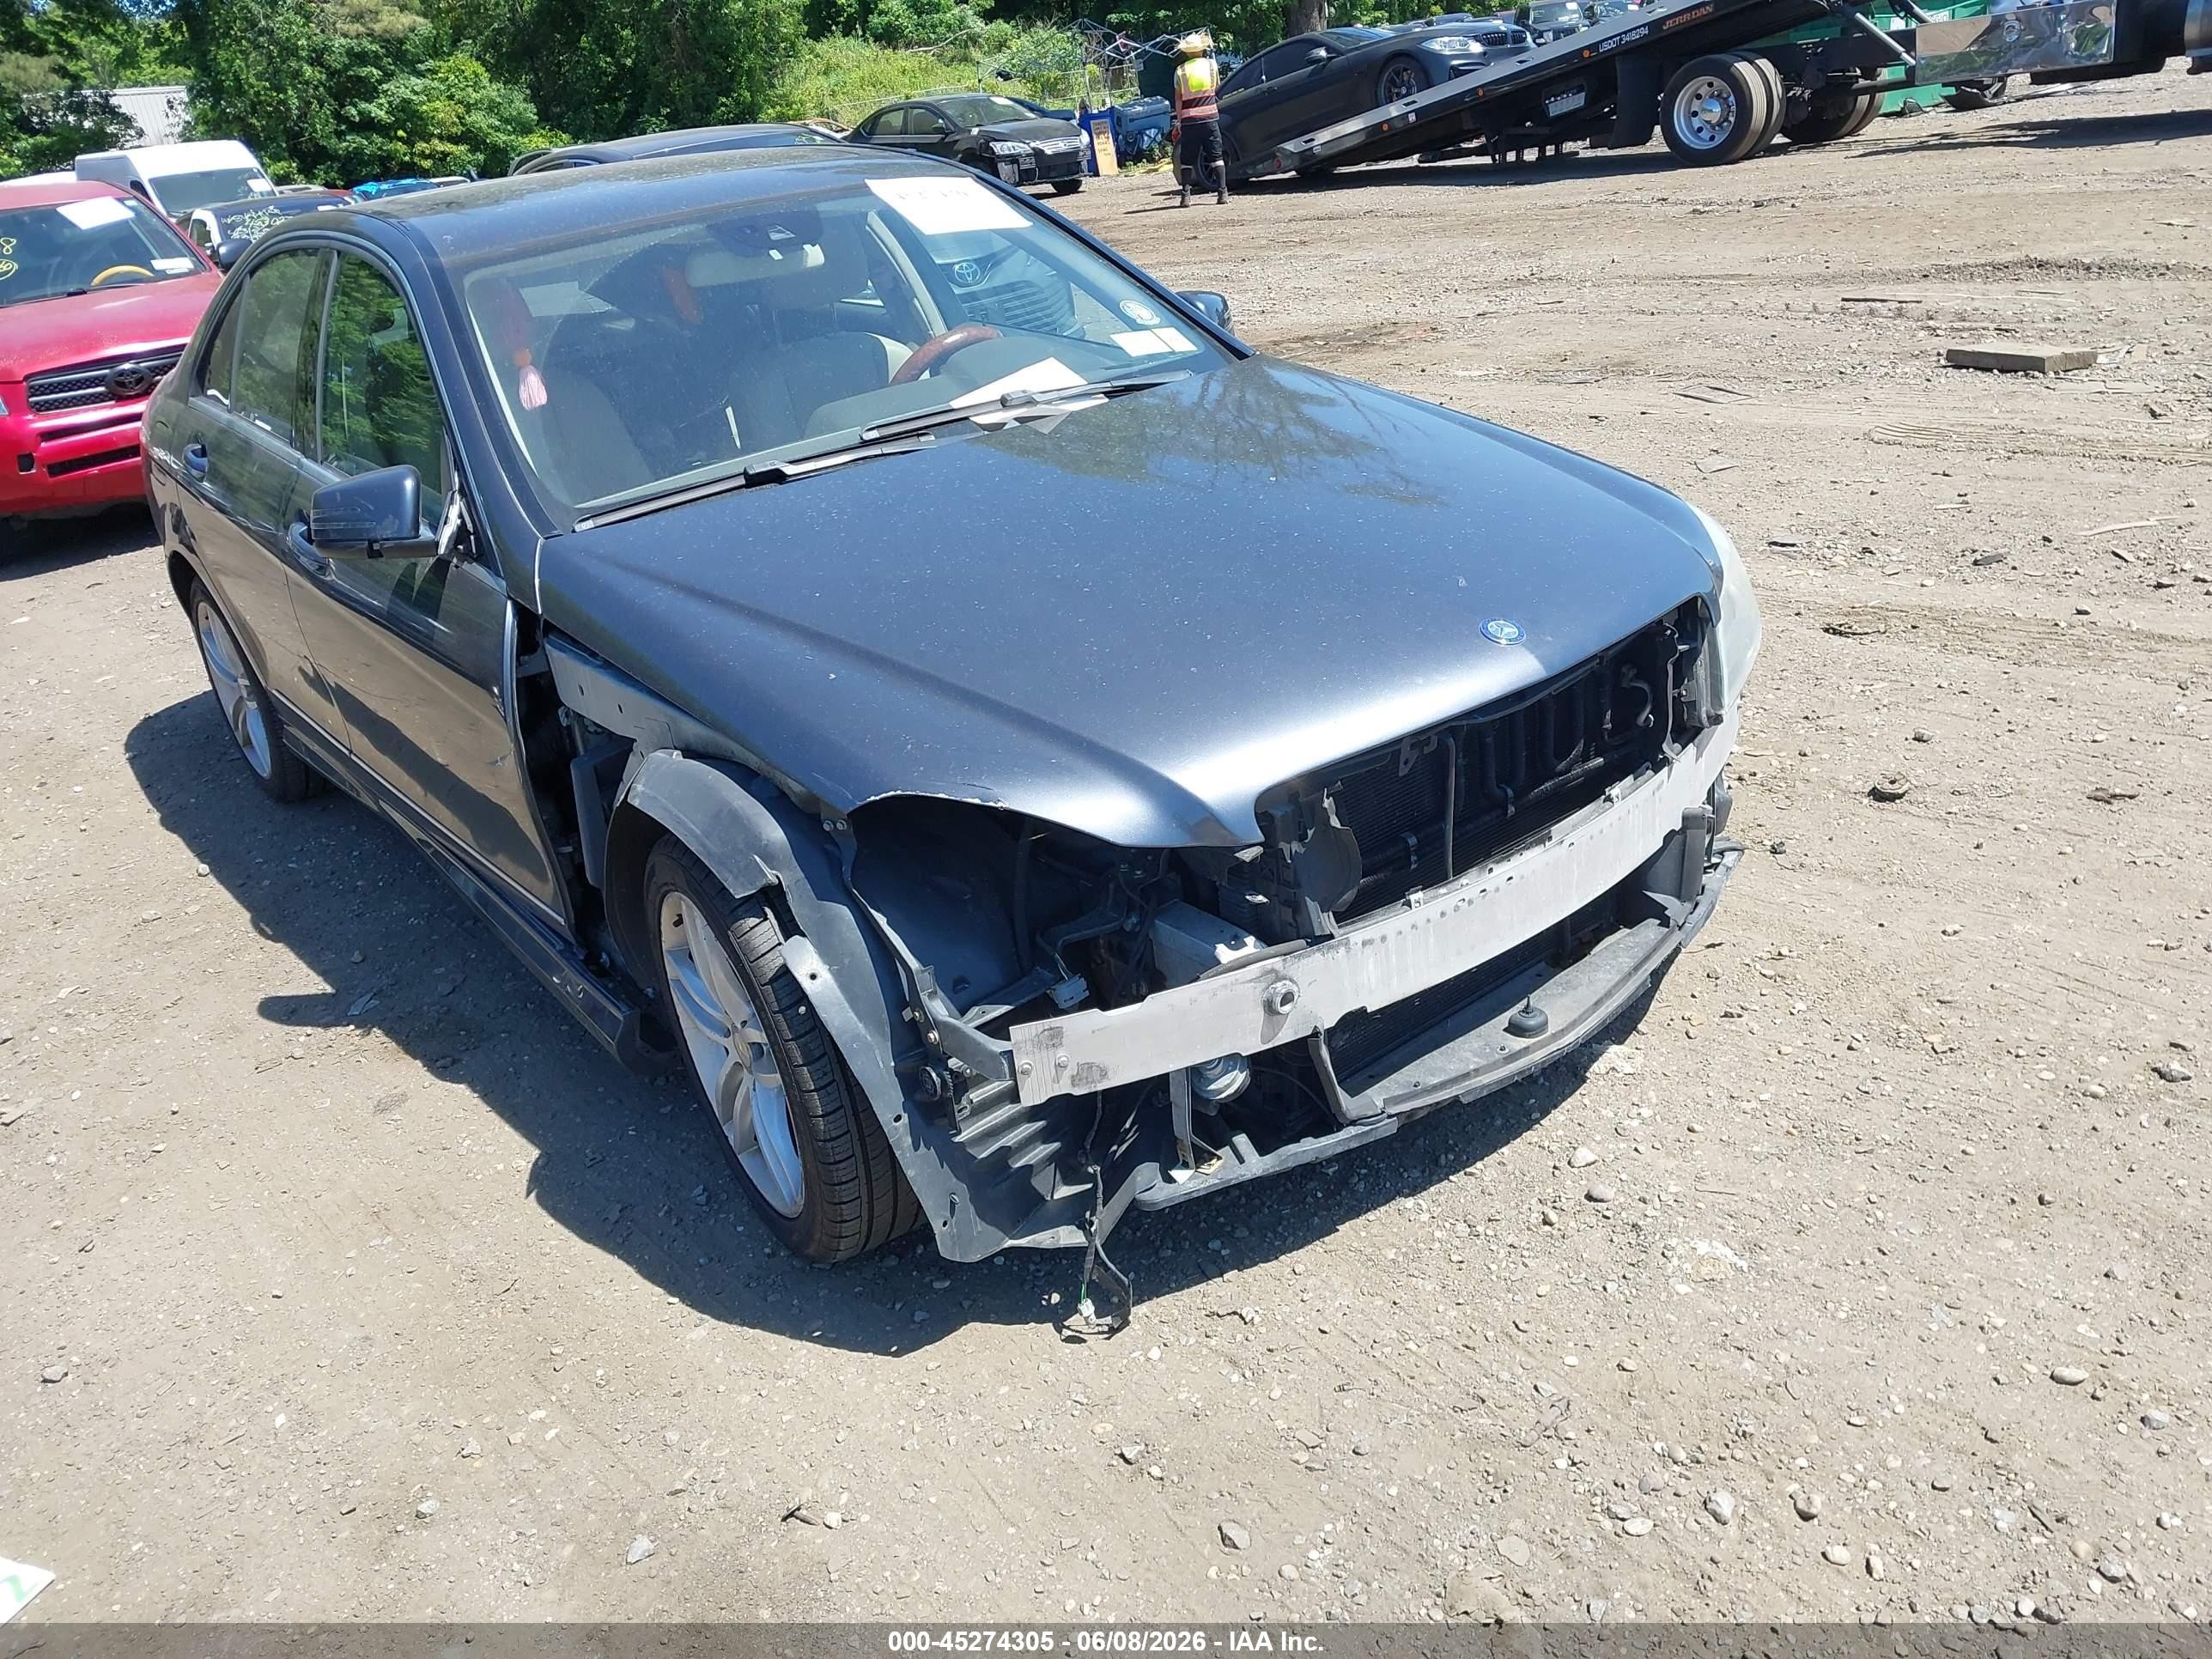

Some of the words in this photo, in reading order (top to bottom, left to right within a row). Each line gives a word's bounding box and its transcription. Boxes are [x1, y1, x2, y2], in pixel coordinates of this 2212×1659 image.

[1662, 12, 1691, 30] JERR
[1691, 4, 1715, 20] DAN
[1599, 36, 1620, 52] USDOT
